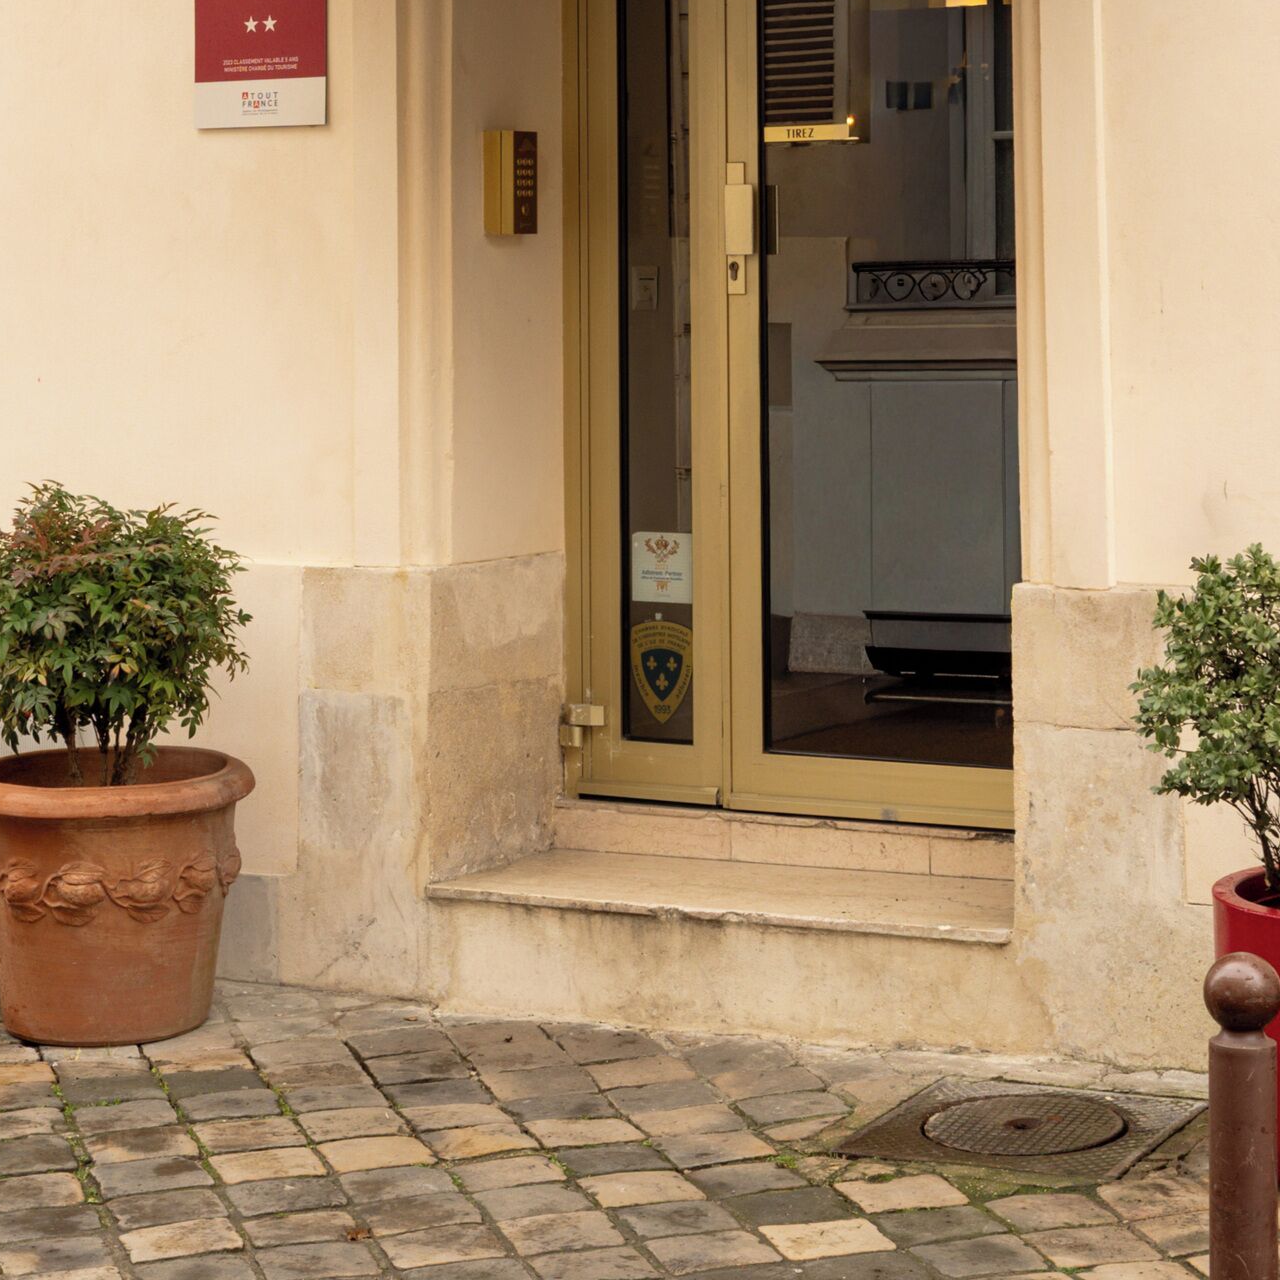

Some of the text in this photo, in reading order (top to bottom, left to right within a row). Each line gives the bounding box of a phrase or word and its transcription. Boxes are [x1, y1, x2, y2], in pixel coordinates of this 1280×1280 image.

[242, 91, 278, 100] ATOUT
[242, 99, 278, 108] FRANCE
[786, 128, 814, 139] TIREZ
